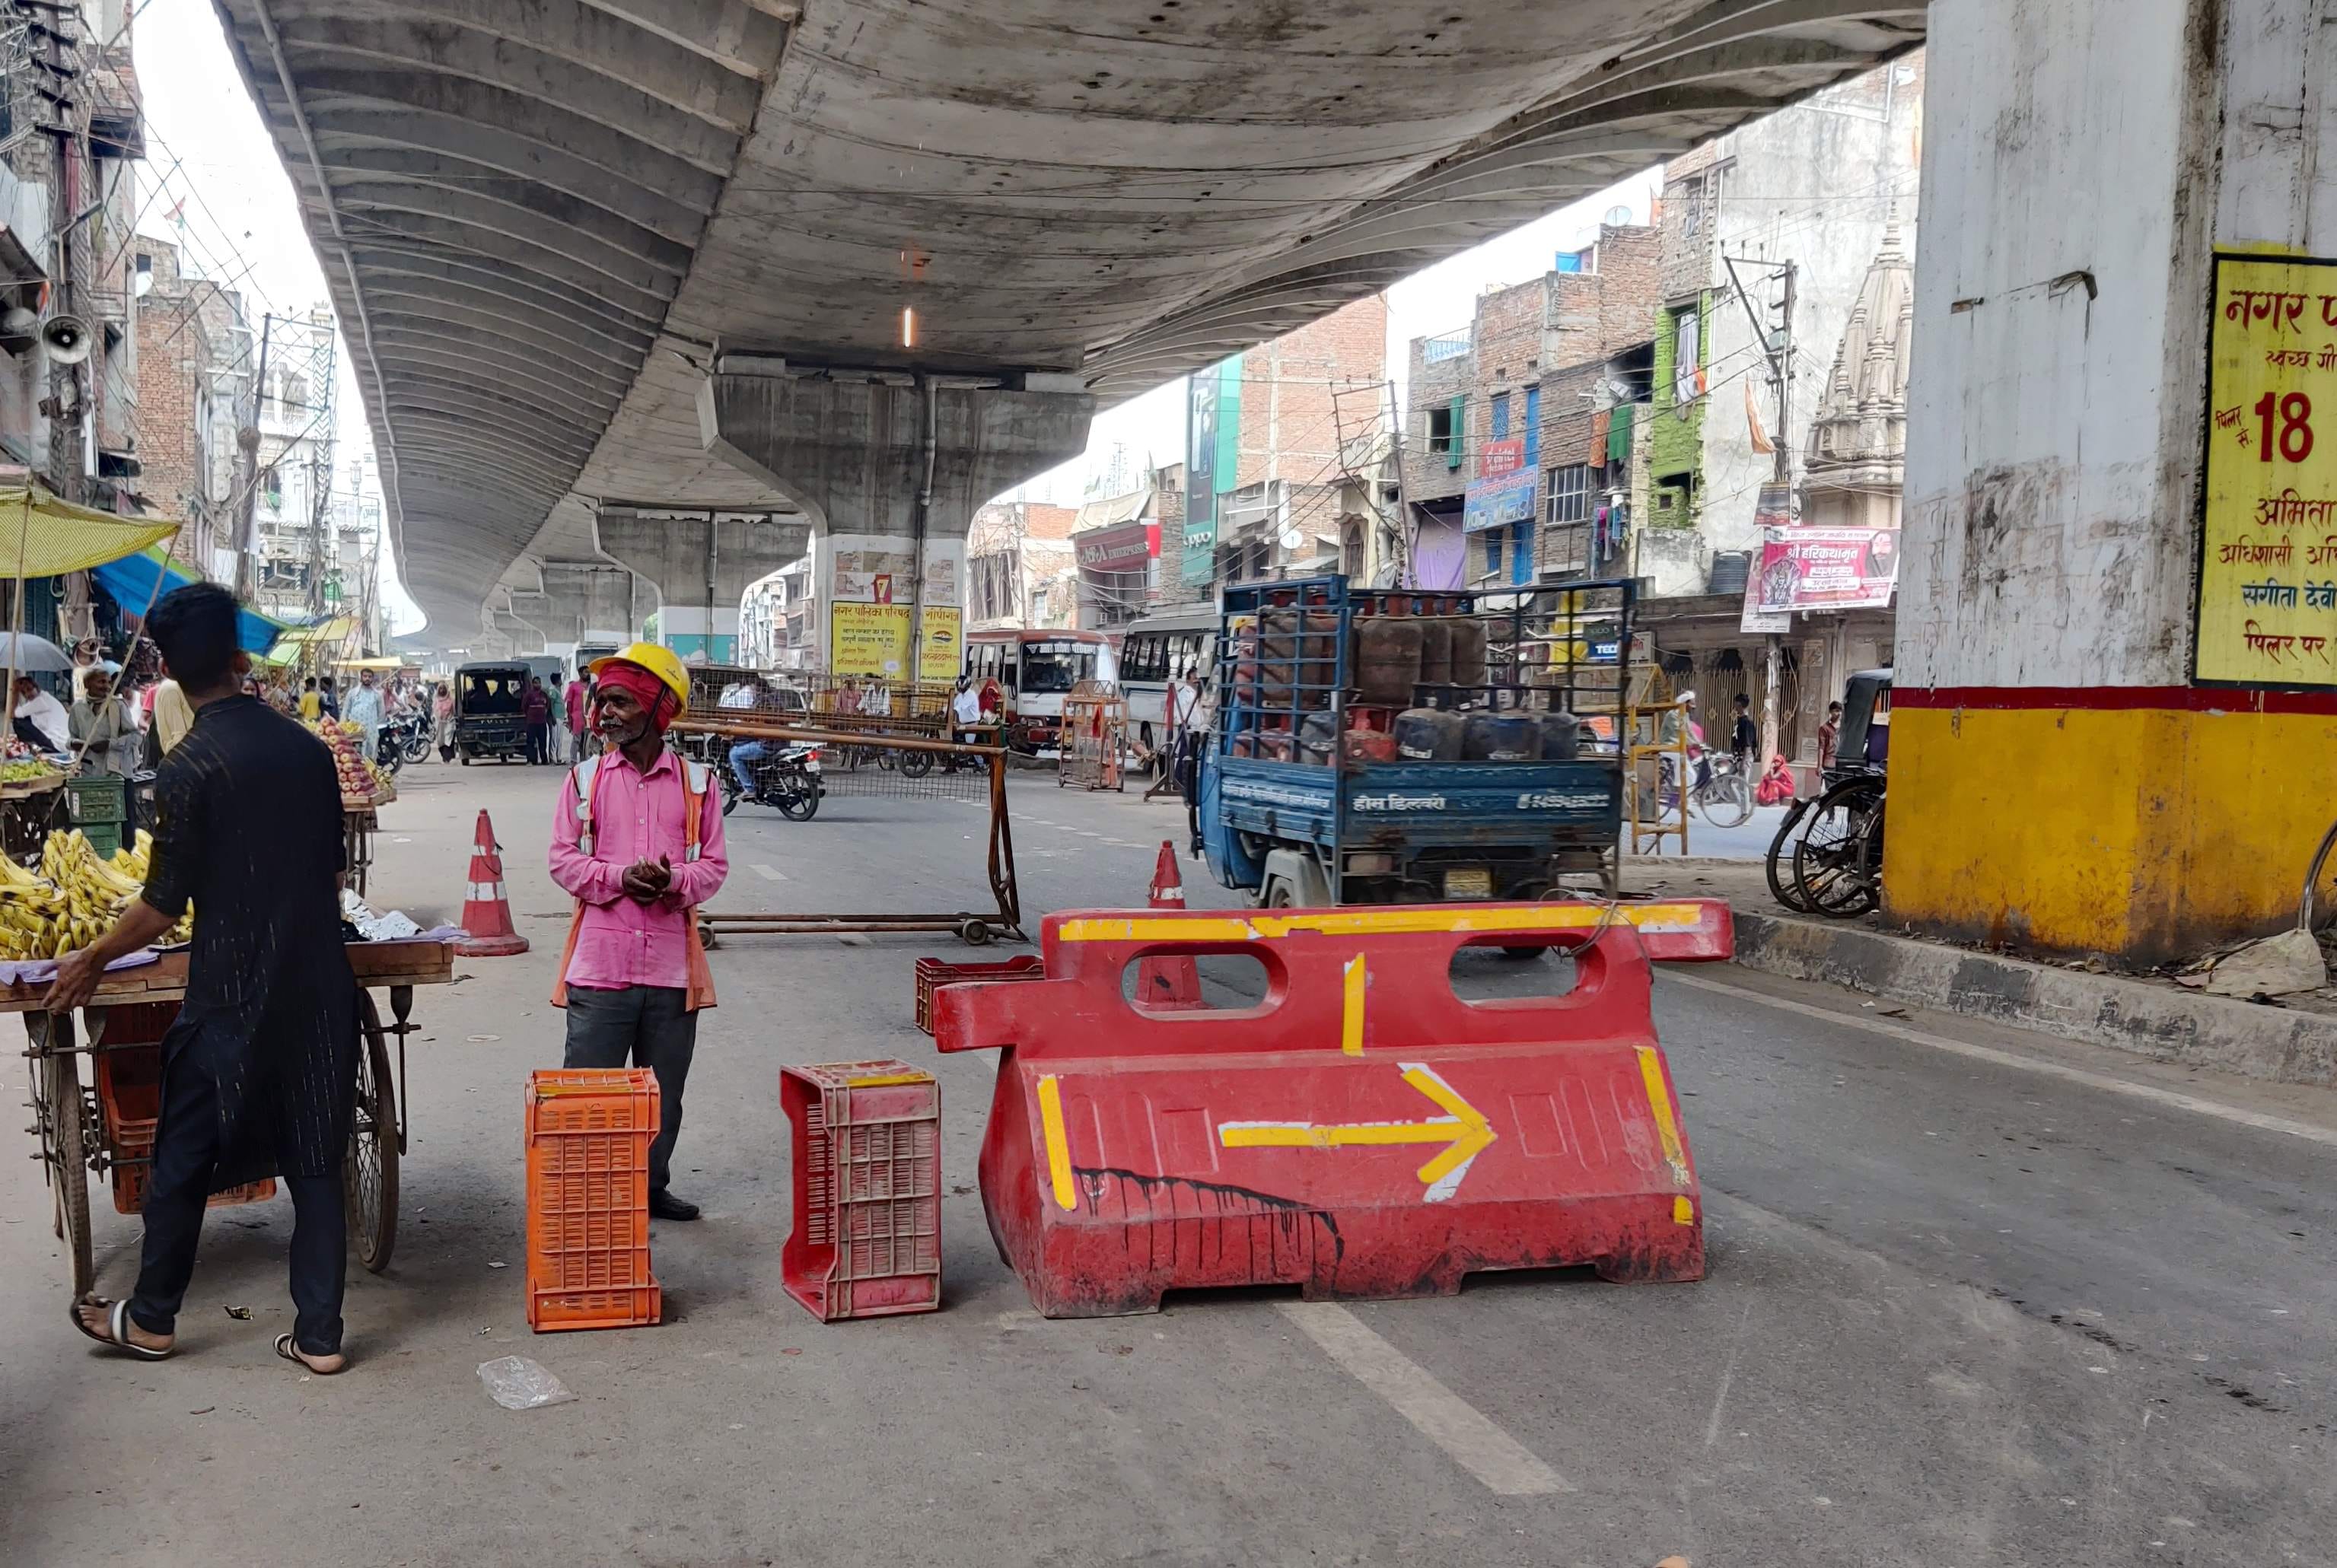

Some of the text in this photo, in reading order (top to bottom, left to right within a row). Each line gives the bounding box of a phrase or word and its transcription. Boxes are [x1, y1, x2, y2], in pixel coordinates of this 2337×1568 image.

[2226, 290, 2310, 334] नगर
[2255, 391, 2313, 463] 18
[1493, 447, 1514, 463] airtel
[2218, 534, 2294, 568] अधिशासी
[2241, 577, 2298, 611] संगीता
[2243, 619, 2330, 665] पिलर पर
